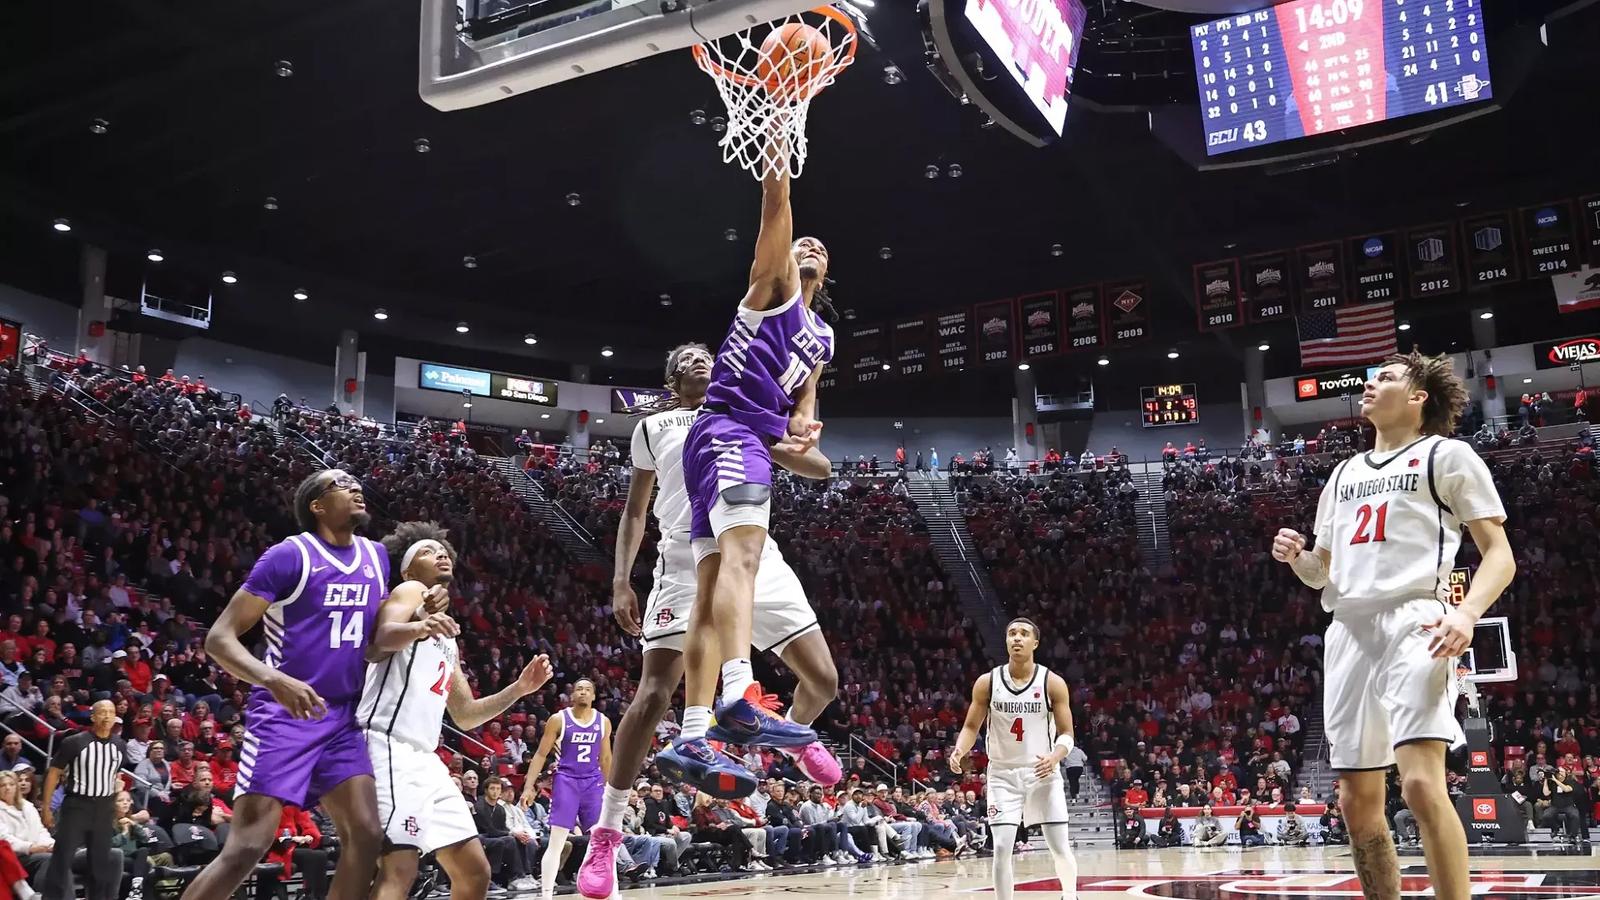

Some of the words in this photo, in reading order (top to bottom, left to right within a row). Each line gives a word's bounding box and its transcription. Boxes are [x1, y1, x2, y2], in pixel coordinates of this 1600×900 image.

[1296, 0, 1363, 33] 14:09
[1400, 11, 1407, 22] 4
[1423, 5, 1431, 16] 4
[1446, 0, 1454, 12] 2
[1216, 20, 1231, 32] PTS
[1402, 28, 1410, 40] 5
[1425, 23, 1433, 34] 4
[1448, 17, 1456, 30] 2
[1468, 14, 1476, 26] 2
[1201, 40, 1208, 51] 2
[1222, 35, 1229, 46] 2
[1243, 30, 1249, 41] 4
[1261, 26, 1267, 37] 1
[1320, 32, 1346, 49] 2ND
[1402, 45, 1415, 58] 21
[1426, 40, 1438, 53] 11
[1451, 35, 1459, 48] 2
[1470, 32, 1478, 44] 0
[1203, 56, 1210, 68] 8
[1225, 52, 1231, 63] 5
[1246, 47, 1251, 58] 1
[1263, 43, 1270, 55] 2
[1403, 63, 1418, 77] 24
[1430, 59, 1438, 70] 4
[1454, 53, 1460, 65] 1
[1472, 50, 1480, 62] 0
[1203, 73, 1216, 85] 10
[1224, 68, 1237, 80] 14
[1247, 64, 1254, 75] 3
[1264, 61, 1272, 72] 0
[1206, 89, 1218, 102] 14
[1228, 85, 1236, 97] 0
[1249, 80, 1256, 92] 0
[1268, 77, 1273, 89] 1
[1425, 82, 1448, 105] 41
[1208, 106, 1221, 118] 32
[1230, 102, 1238, 114] 0
[1252, 98, 1258, 109] 1
[1269, 94, 1276, 106] 0
[1209, 128, 1238, 146] GCU
[1243, 120, 1267, 142] 43
[1532, 245, 1557, 256] SWEET
[1479, 268, 1507, 280] 2014
[1539, 260, 1568, 272] 2014
[1367, 288, 1390, 299] 2011
[1421, 279, 1450, 291] 2012
[1313, 296, 1336, 308] 2011
[1209, 314, 1233, 325] 2010
[1261, 305, 1283, 317] 2011
[939, 325, 966, 337] WAC
[1117, 328, 1143, 339] 2009
[791, 326, 826, 366] GCU
[1029, 344, 1053, 354] 2006
[1073, 335, 1097, 347] 2006
[985, 350, 1007, 360] 2002
[1552, 343, 1597, 360] VIEJAS
[778, 351, 812, 396] 10
[1158, 385, 1181, 395] 14:09
[1320, 377, 1363, 390] TOYOTA
[1146, 402, 1158, 411] 41
[1183, 399, 1195, 409] 43
[658, 420, 674, 431] SAN
[1340, 484, 1354, 502] SAN
[1357, 477, 1386, 498] DIEGO
[1386, 473, 1419, 492] STATE
[1350, 501, 1389, 545] 21
[323, 584, 370, 606] GCU
[328, 611, 364, 649] 14
[993, 701, 1003, 713] SAN
[1003, 702, 1023, 714] DIEGO
[1024, 701, 1041, 713] STATE
[571, 732, 598, 743] GCU
[1010, 718, 1025, 741] 4
[577, 745, 591, 763] 2
